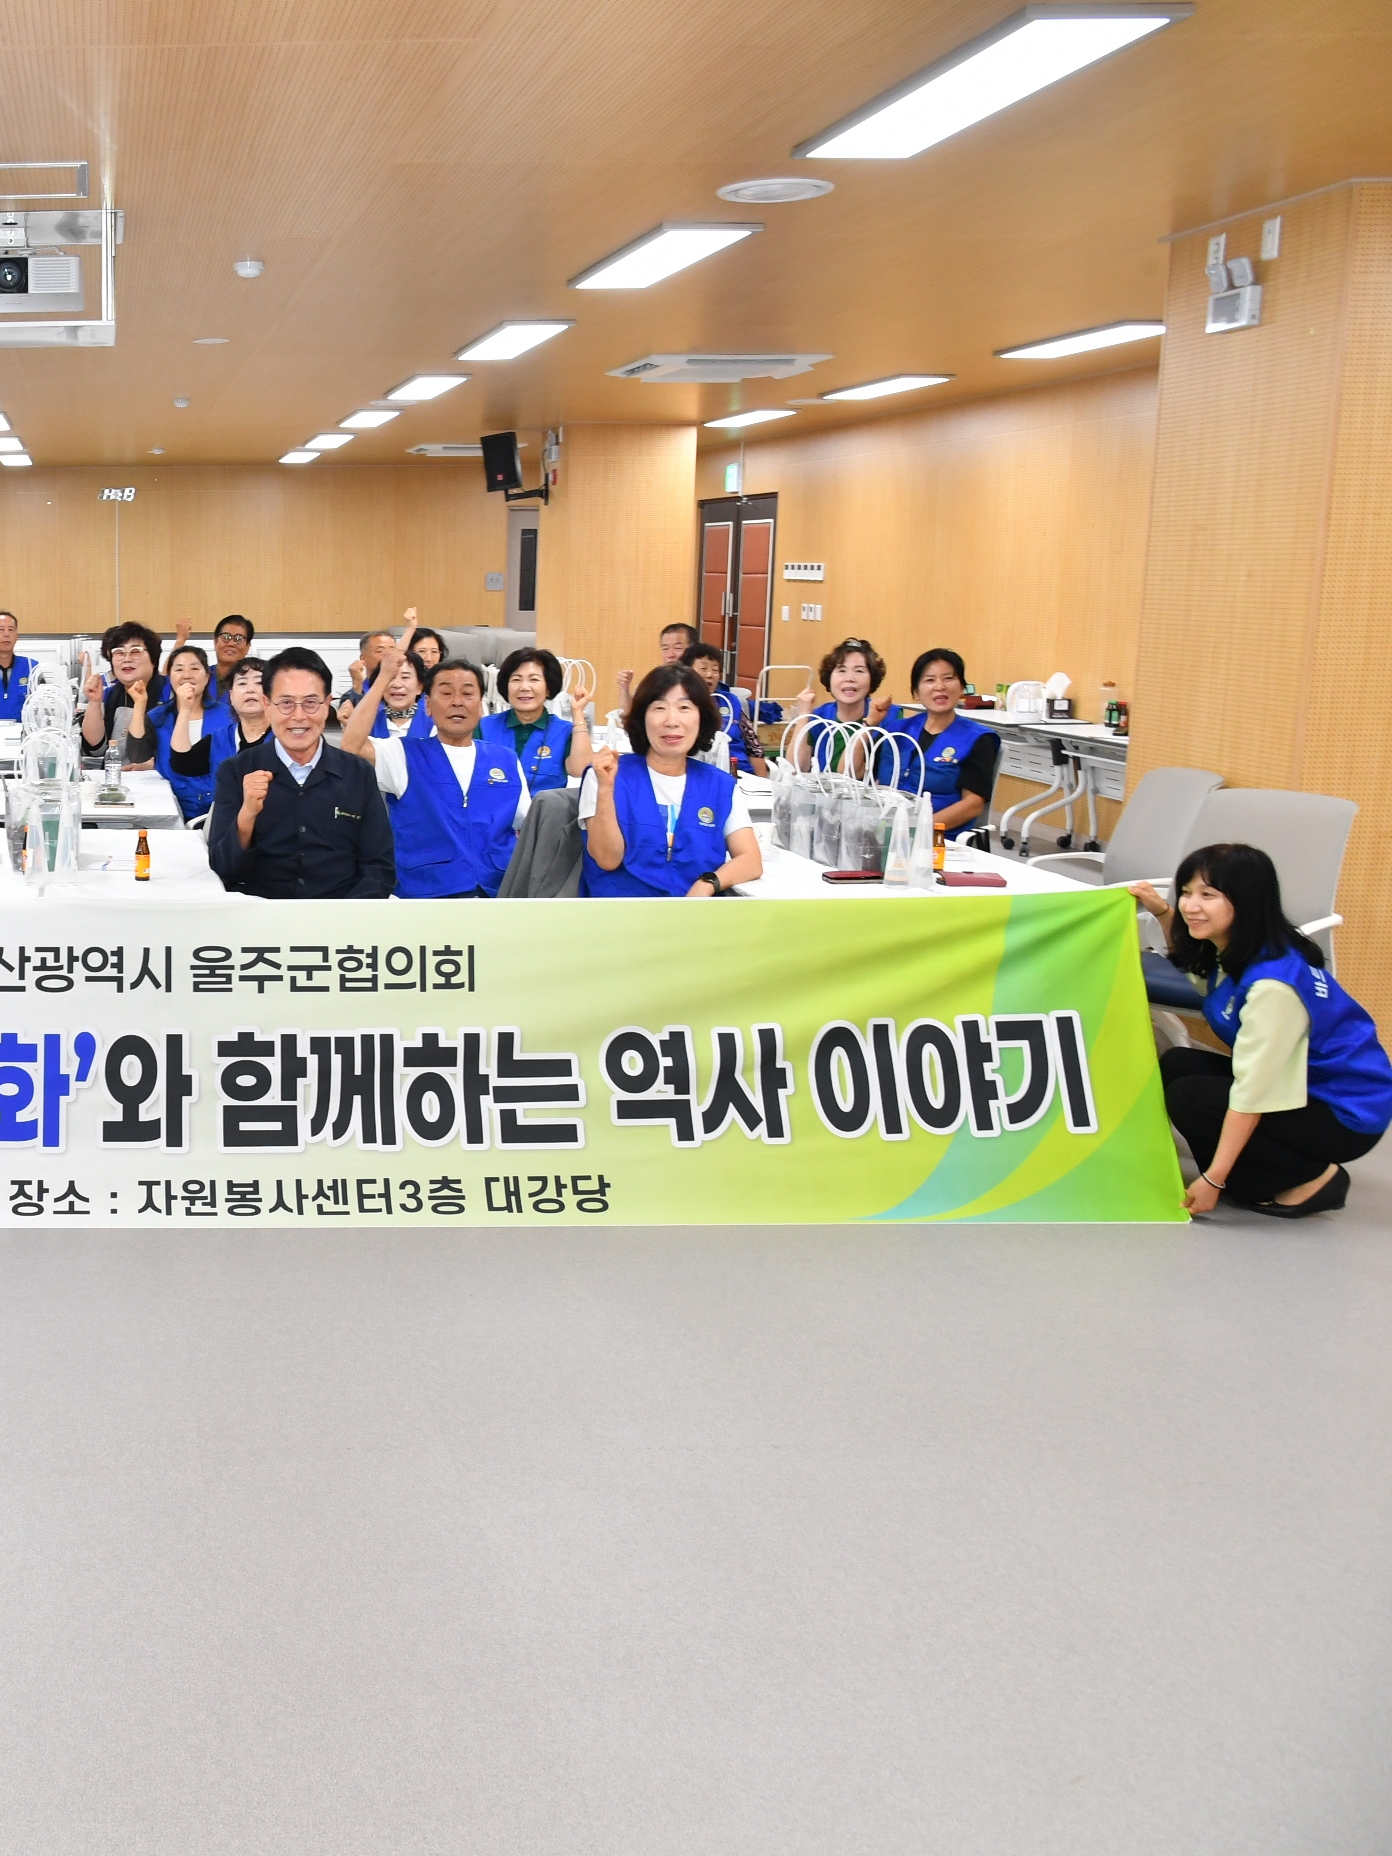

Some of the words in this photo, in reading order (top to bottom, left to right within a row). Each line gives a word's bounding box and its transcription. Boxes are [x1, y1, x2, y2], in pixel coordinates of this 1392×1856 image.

[190, 944, 477, 995] 울주군협의회
[217, 1030, 582, 1150] 함께하는
[607, 1028, 790, 1143] 역사
[813, 1015, 1094, 1136] 이야기
[9, 1179, 92, 1217] 장소
[138, 1176, 467, 1218] 자원봉사센터3층
[484, 1174, 612, 1215] 대강당
